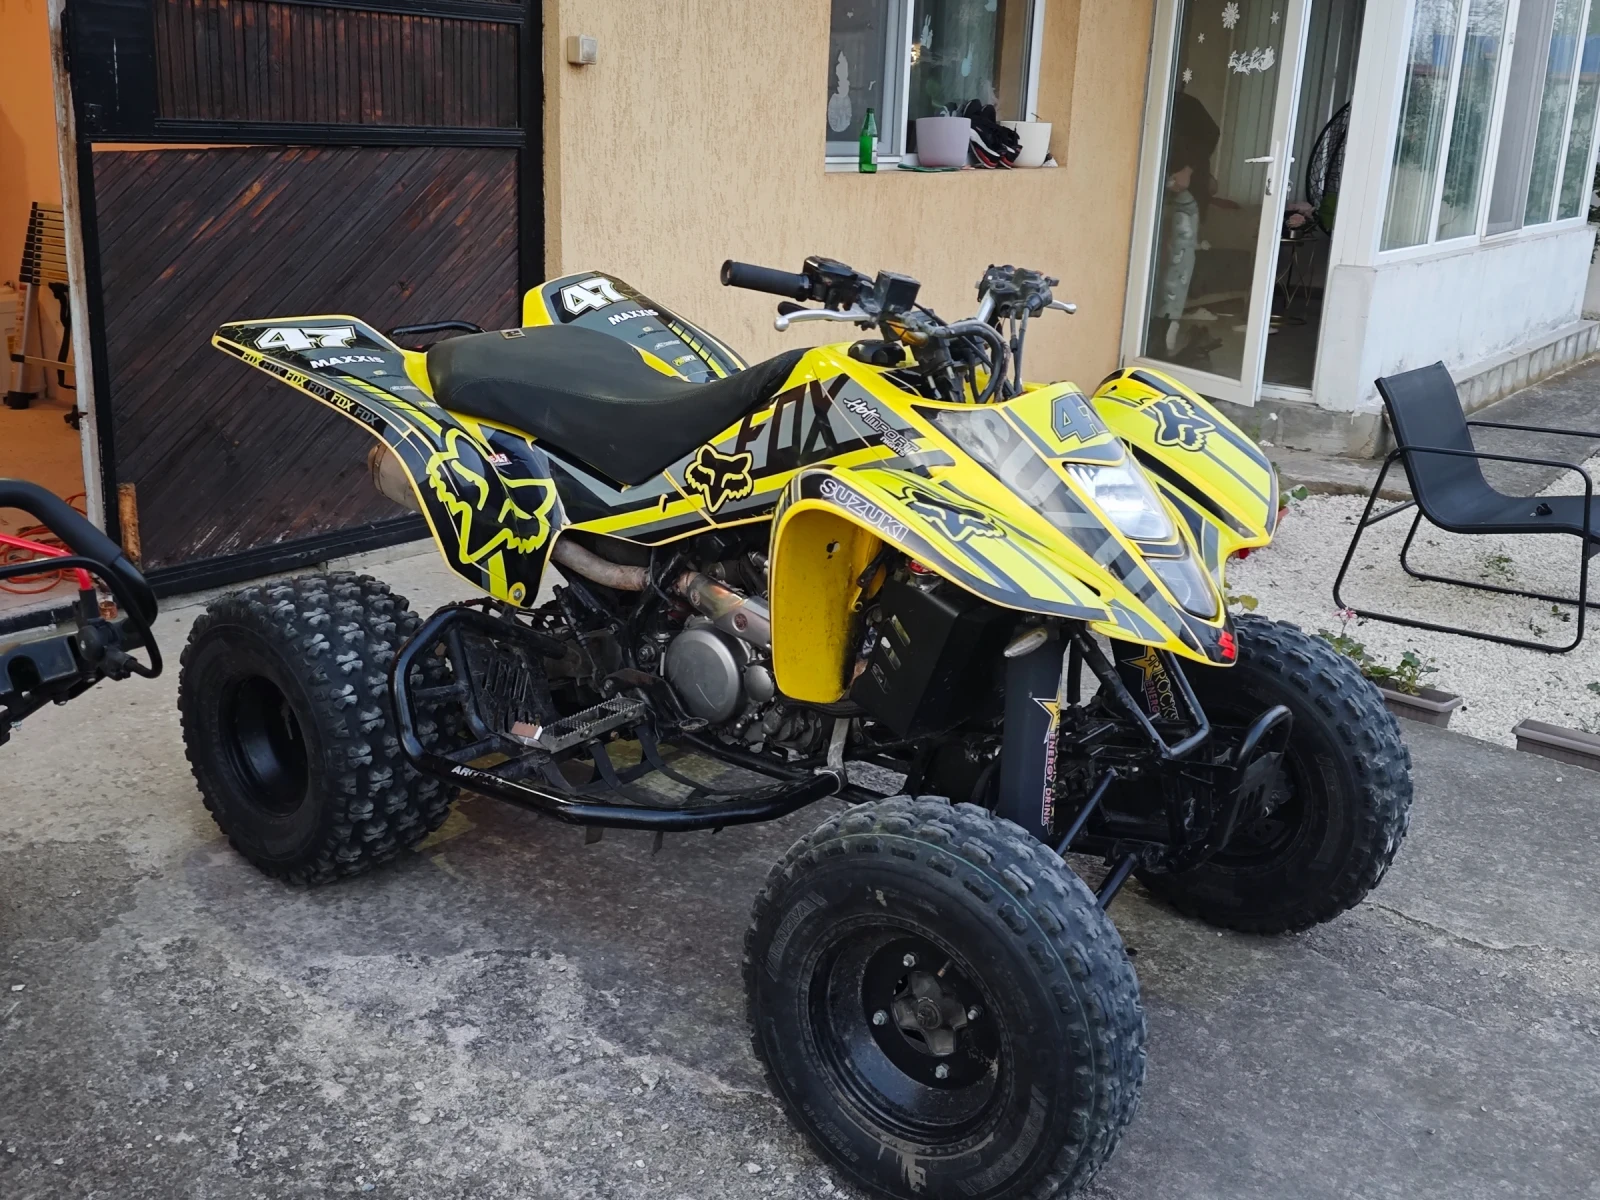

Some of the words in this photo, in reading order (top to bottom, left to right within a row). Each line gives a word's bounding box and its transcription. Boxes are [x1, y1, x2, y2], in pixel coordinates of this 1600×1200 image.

[560, 276, 629, 315] 47
[607, 309, 659, 326] MAXXIS
[254, 326, 356, 351] 47
[310, 355, 385, 369] MAXXIS
[242, 352, 261, 367] FOX
[262, 360, 284, 375] FOX
[284, 371, 309, 388] FOX
[307, 382, 331, 399] FOX
[330, 393, 355, 412] FOX
[354, 408, 380, 426] FOX
[820, 477, 910, 542] SUZUKI
[1043, 786, 1053, 825] DRINK
